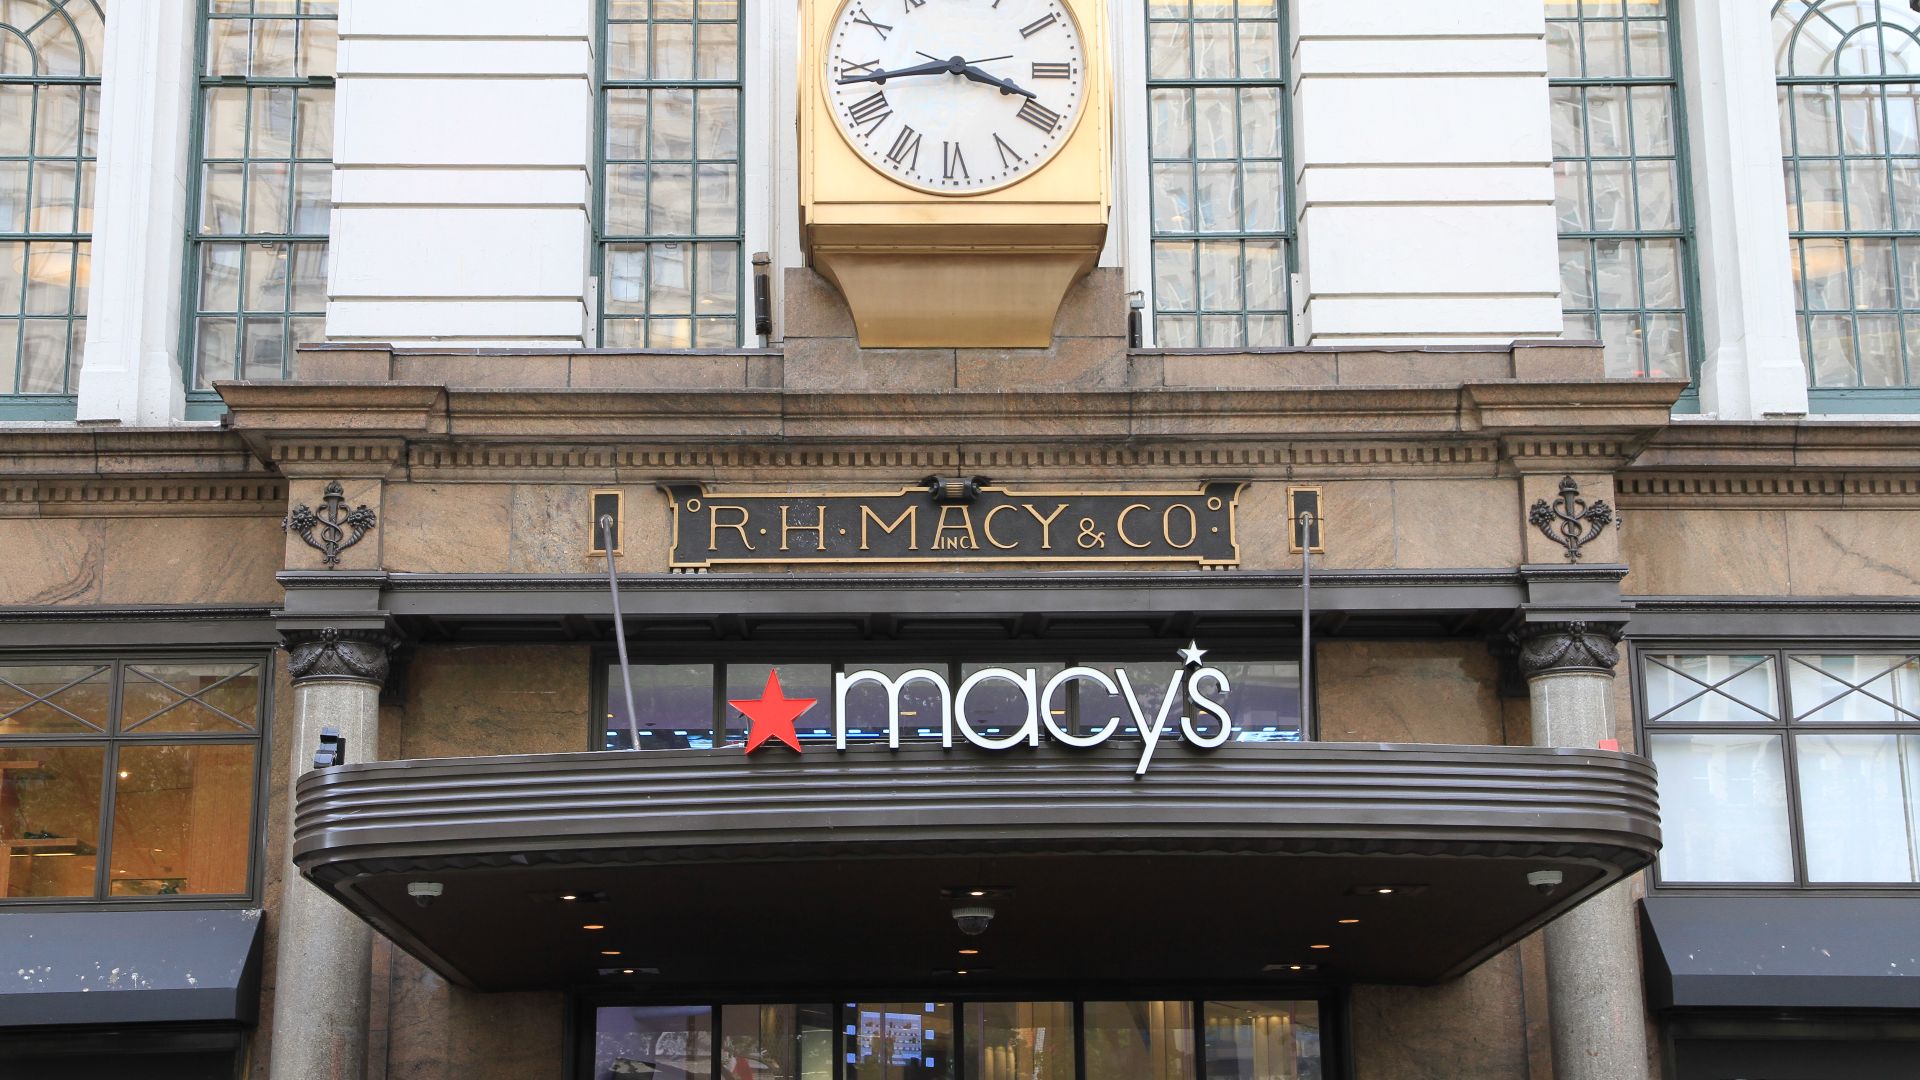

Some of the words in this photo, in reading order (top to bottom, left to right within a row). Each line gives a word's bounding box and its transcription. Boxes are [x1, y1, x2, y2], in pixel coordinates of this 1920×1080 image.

[853, 8, 893, 40] X
[1019, 12, 1057, 39] II
[1032, 62, 1070, 79] III
[848, 90, 893, 138] VIII
[886, 125, 922, 171] VII
[943, 141, 970, 178] VI
[993, 133, 1022, 169] V
[940, 536, 970, 549] INC
[1077, 517, 1106, 549] &
